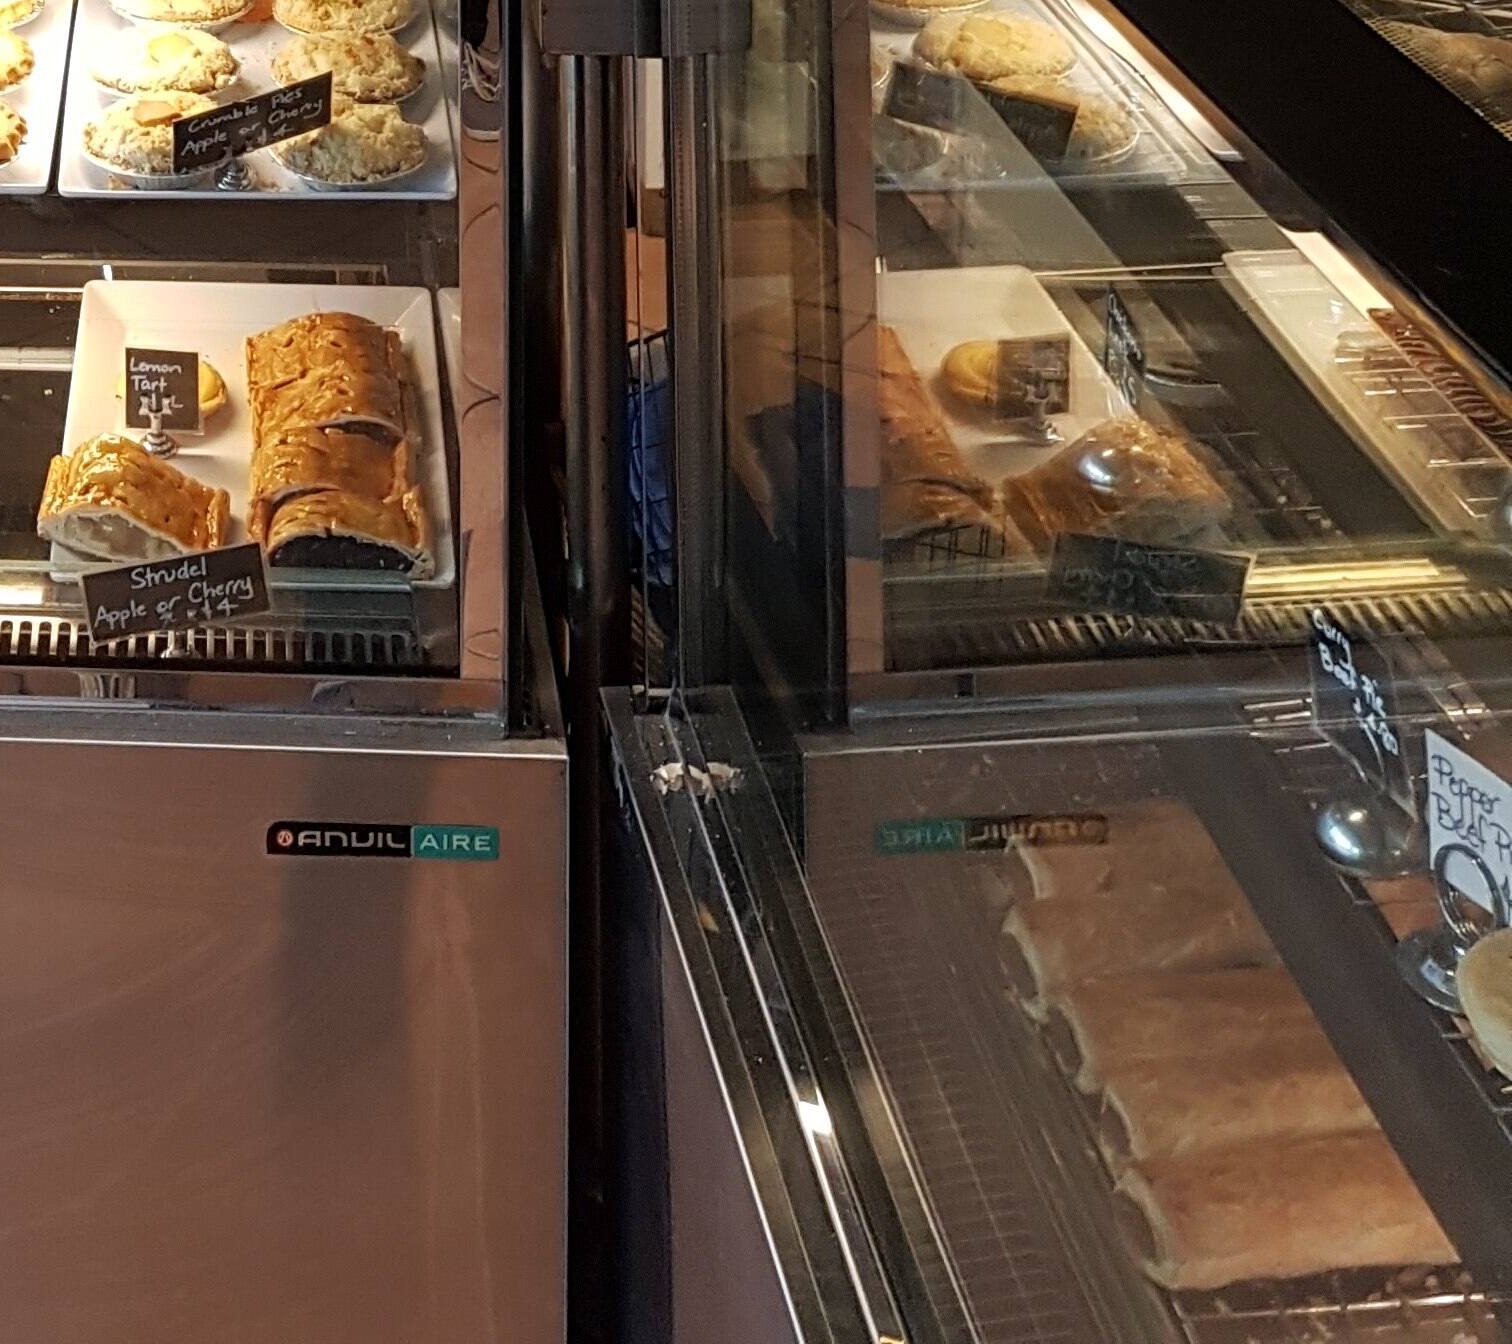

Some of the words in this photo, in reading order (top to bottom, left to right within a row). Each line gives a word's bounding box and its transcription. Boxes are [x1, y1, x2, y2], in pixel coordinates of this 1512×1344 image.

[188, 104, 258, 135] Crumble
[271, 87, 304, 109] Pies
[180, 129, 228, 157] Apple
[239, 120, 262, 136] or
[129, 356, 182, 374] Lemon
[130, 374, 168, 393] Tart
[130, 556, 208, 590] Strudel
[94, 599, 148, 631] Apple
[155, 595, 182, 614] or
[188, 576, 255, 604] Cherry
[298, 830, 406, 849] ANVIL
[419, 833, 491, 852] AIRE
